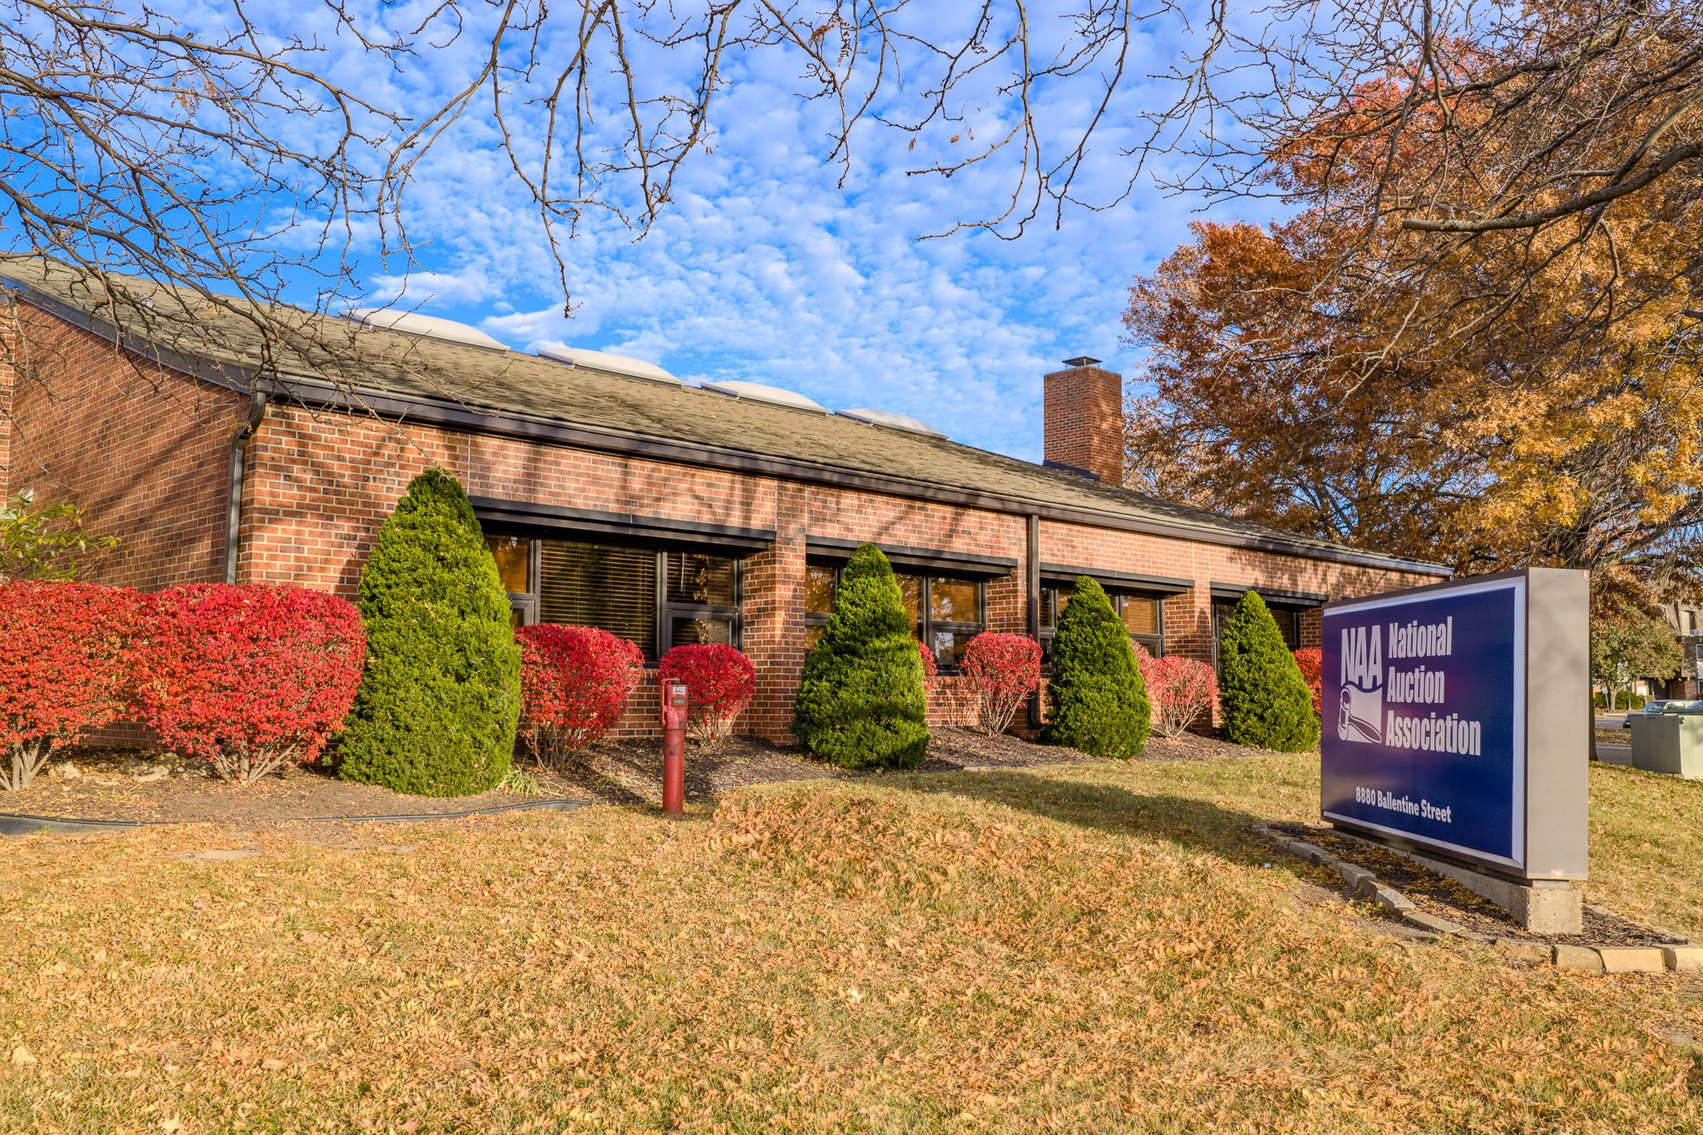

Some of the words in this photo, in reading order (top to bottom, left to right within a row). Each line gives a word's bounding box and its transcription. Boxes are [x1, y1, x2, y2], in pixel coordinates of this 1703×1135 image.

[1341, 625, 1383, 689] NAA
[1388, 616, 1453, 659] National
[1387, 665, 1445, 704] Auction
[1386, 710, 1481, 756] Association
[1355, 786, 1376, 806] 8880
[1377, 790, 1420, 816] Ballentine
[1421, 799, 1452, 823] Street
